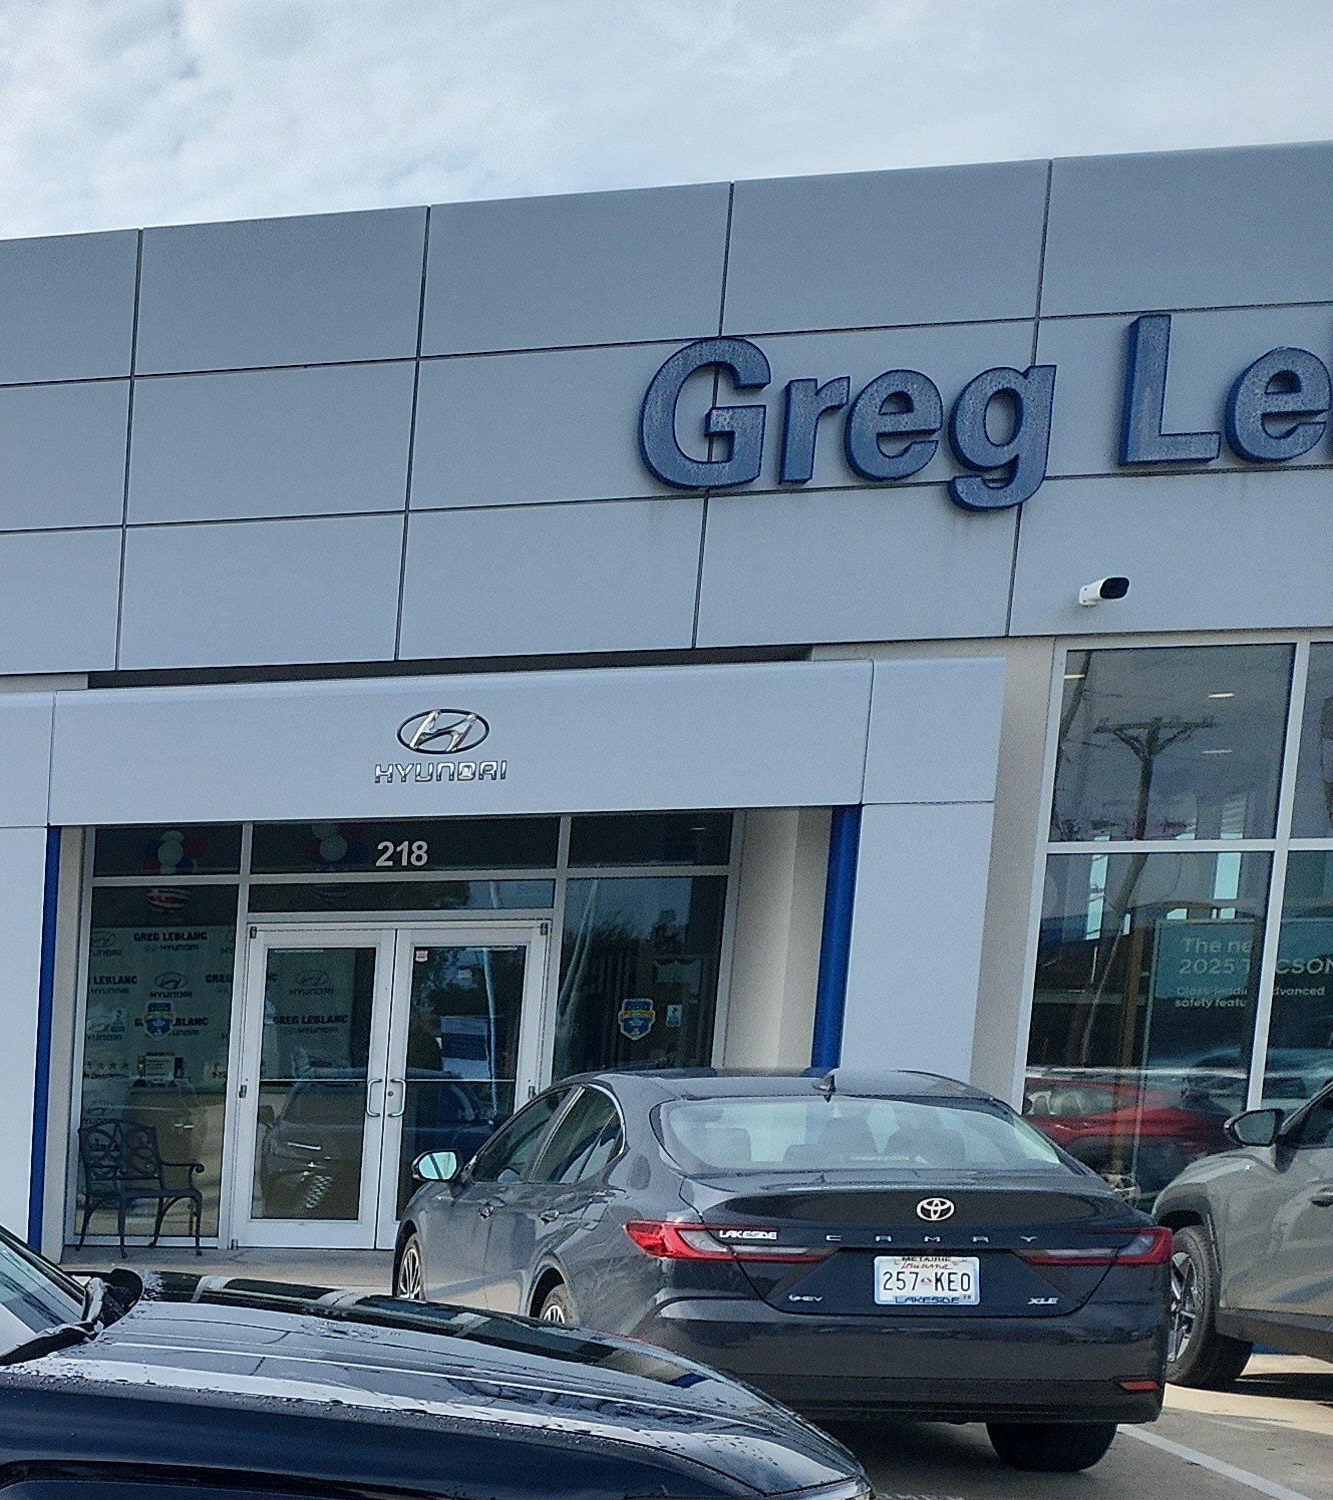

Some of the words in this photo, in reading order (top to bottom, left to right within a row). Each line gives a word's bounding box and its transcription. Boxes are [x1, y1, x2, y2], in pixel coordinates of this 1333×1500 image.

[638, 336, 1057, 511] Greg
[1119, 314, 1333, 467] Le
[375, 760, 508, 783] HYUNDAI
[375, 840, 428, 867] 218
[134, 931, 160, 942] GREG
[162, 931, 208, 942] LEBLANC
[1182, 937, 1222, 954] The
[1227, 940, 1252, 954] ne
[1179, 958, 1235, 975] 2025
[1273, 986, 1326, 997] dvanced
[1175, 997, 1213, 1009] safety
[1214, 998, 1247, 1008] featu
[173, 1017, 210, 1027] BLANC
[719, 1230, 778, 1240] LAKESIDE
[825, 1234, 1038, 1243] CAMRY
[882, 1271, 920, 1291] 257
[934, 1271, 971, 1292] KEO
[894, 1296, 960, 1304] LAKESIDE
[1027, 1297, 1059, 1305] XLE
